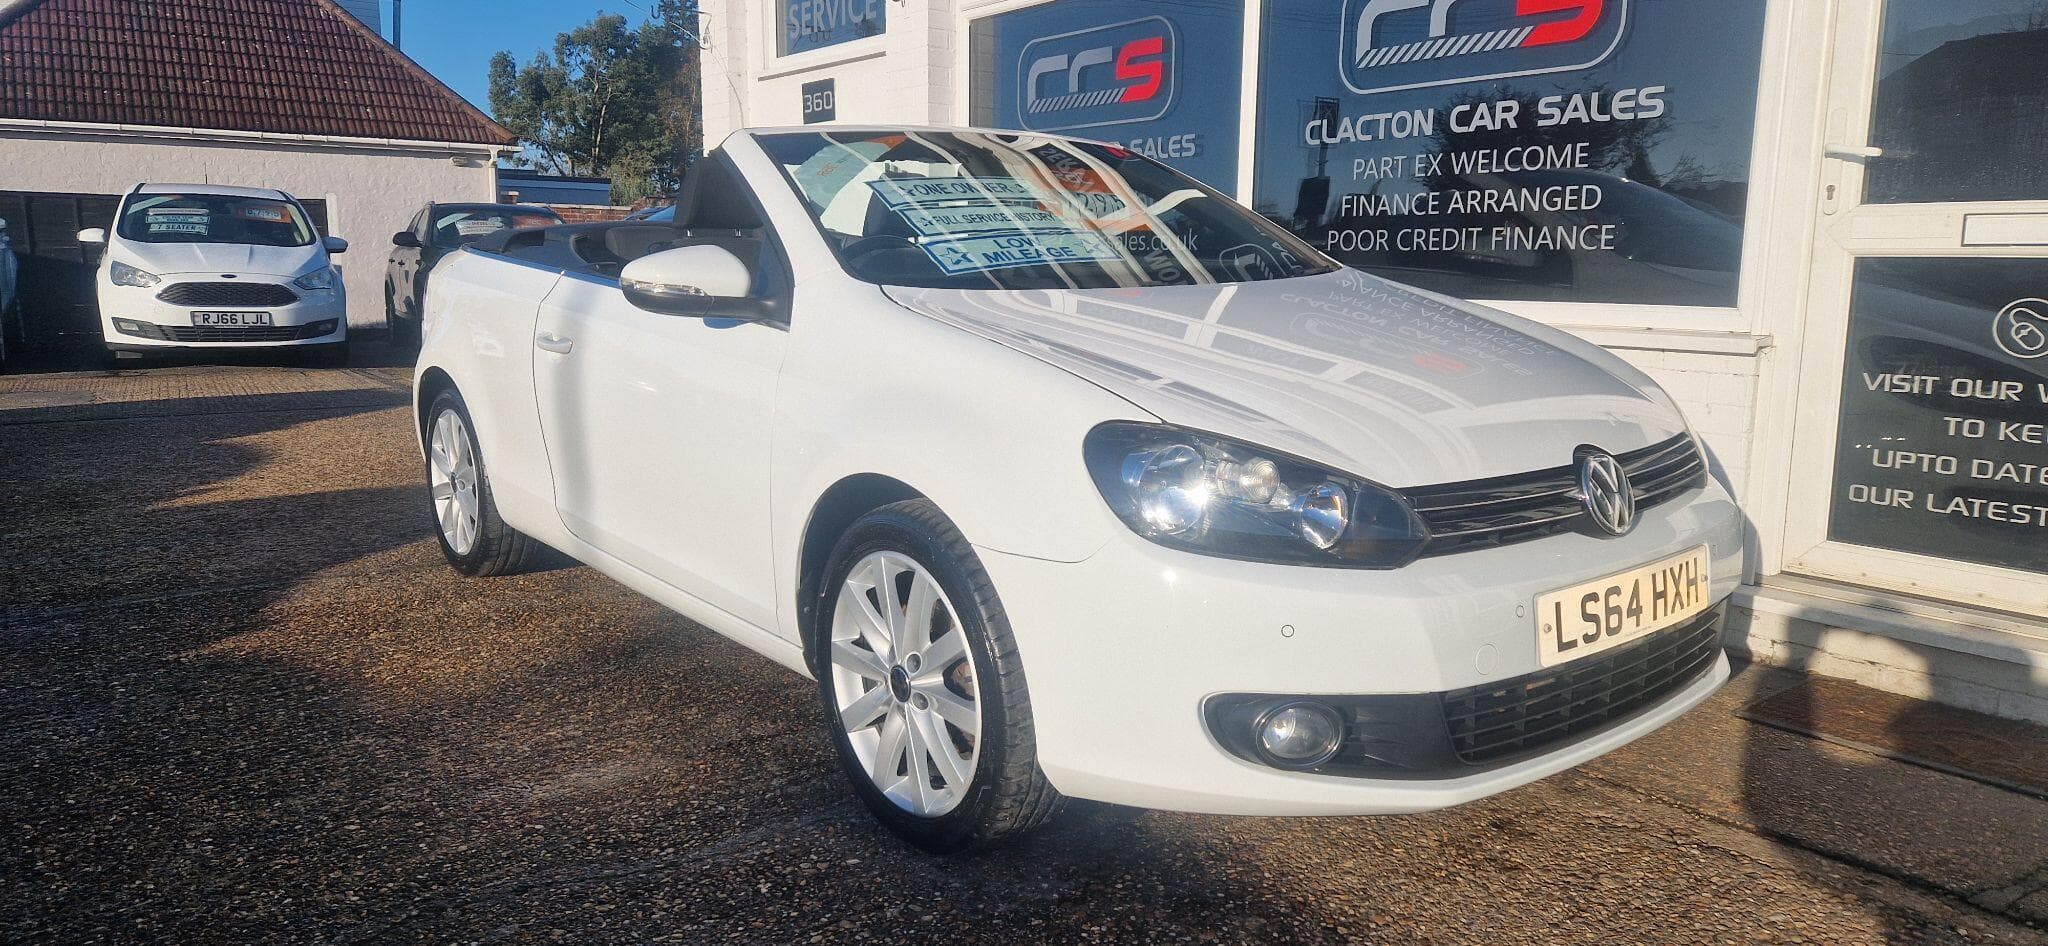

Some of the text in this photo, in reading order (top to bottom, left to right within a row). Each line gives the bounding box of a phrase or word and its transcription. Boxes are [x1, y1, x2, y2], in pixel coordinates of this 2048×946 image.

[789, 0, 877, 39] SERVICE
[804, 91, 833, 113] 360
[1305, 85, 1666, 145] CLACTON CAR SALES
[1129, 133, 1196, 159] SALES
[1353, 142, 1590, 180] PART EX WELCOME
[913, 183, 951, 195] ONE
[1341, 184, 1602, 217] FINANCE ARRANGED
[934, 216, 959, 224] FULL
[962, 213, 1008, 223] SERVICE
[993, 238, 1041, 249] LOW
[1327, 224, 1615, 251] POOR CREDIT FINANCE
[982, 247, 1077, 263] MILEAGE
[203, 312, 268, 325] RJ66 LJL
[1863, 372, 1940, 395] VISIT
[1951, 378, 2024, 401] OUR
[1943, 416, 2048, 445] TO KE
[1872, 448, 1957, 475] UPTO
[1848, 484, 2048, 527] OUR LATEST
[1555, 557, 1699, 652] LS64 HXH
